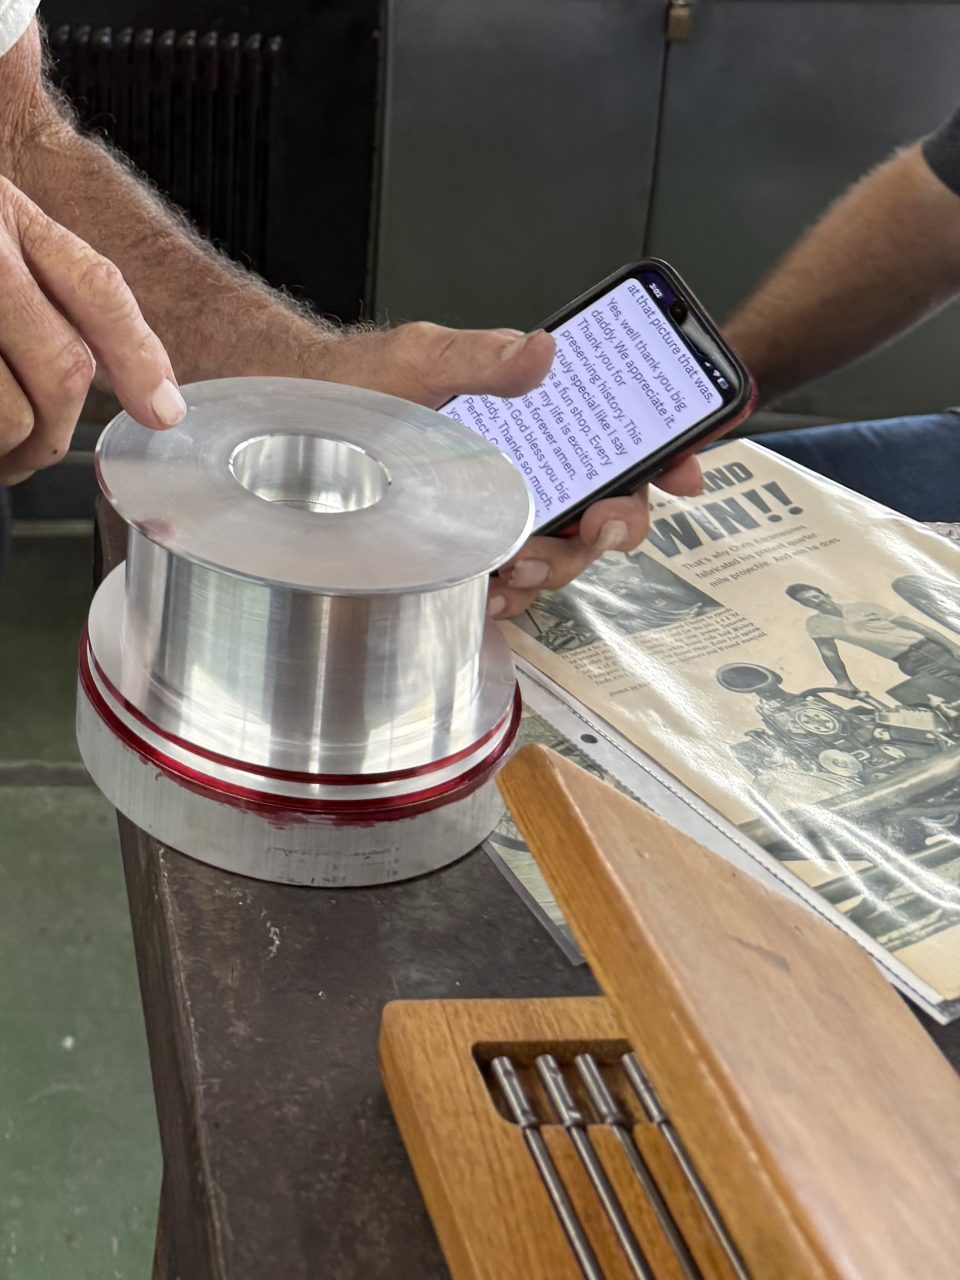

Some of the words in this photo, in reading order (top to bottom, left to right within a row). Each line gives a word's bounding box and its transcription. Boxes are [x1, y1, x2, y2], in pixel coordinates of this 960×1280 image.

[560, 329, 601, 384] preserving
[597, 380, 625, 422] history.
[624, 418, 641, 445] This
[577, 316, 601, 352] Thank
[595, 350, 613, 371] you
[611, 369, 625, 386] for
[591, 309, 615, 343] daddy.
[614, 339, 628, 360] We
[626, 359, 666, 416] appreciate
[607, 296, 621, 320] Yes,
[620, 318, 640, 341] well
[635, 339, 659, 372] thank
[653, 370, 673, 392] you
[670, 390, 686, 412] big
[628, 284, 639, 297] at
[636, 294, 655, 319] that
[648, 317, 679, 356] picture
[678, 353, 697, 379] that
[694, 376, 712, 403] was.
[530, 406, 556, 444] forever
[553, 446, 575, 480] amen.
[539, 389, 552, 407] my
[549, 405, 563, 424] life
[559, 422, 571, 435] is
[568, 435, 598, 480] exciting
[552, 379, 561, 389] a
[558, 386, 573, 406] fun
[570, 406, 590, 436] shop.
[589, 434, 611, 466] Every
[555, 348, 573, 374] truly
[570, 373, 599, 411] special
[594, 408, 610, 431] like
[611, 436, 627, 455] say
[479, 391, 499, 423] addy.
[498, 419, 523, 461] Thanks
[520, 460, 532, 475] so
[529, 474, 551, 510] much.
[511, 408, 529, 433] God
[525, 430, 544, 462] bless
[538, 460, 557, 483] you
[554, 480, 569, 503] big
[682, 555, 711, 570] That's
[711, 548, 730, 561] why
[696, 558, 740, 579] fabricated
